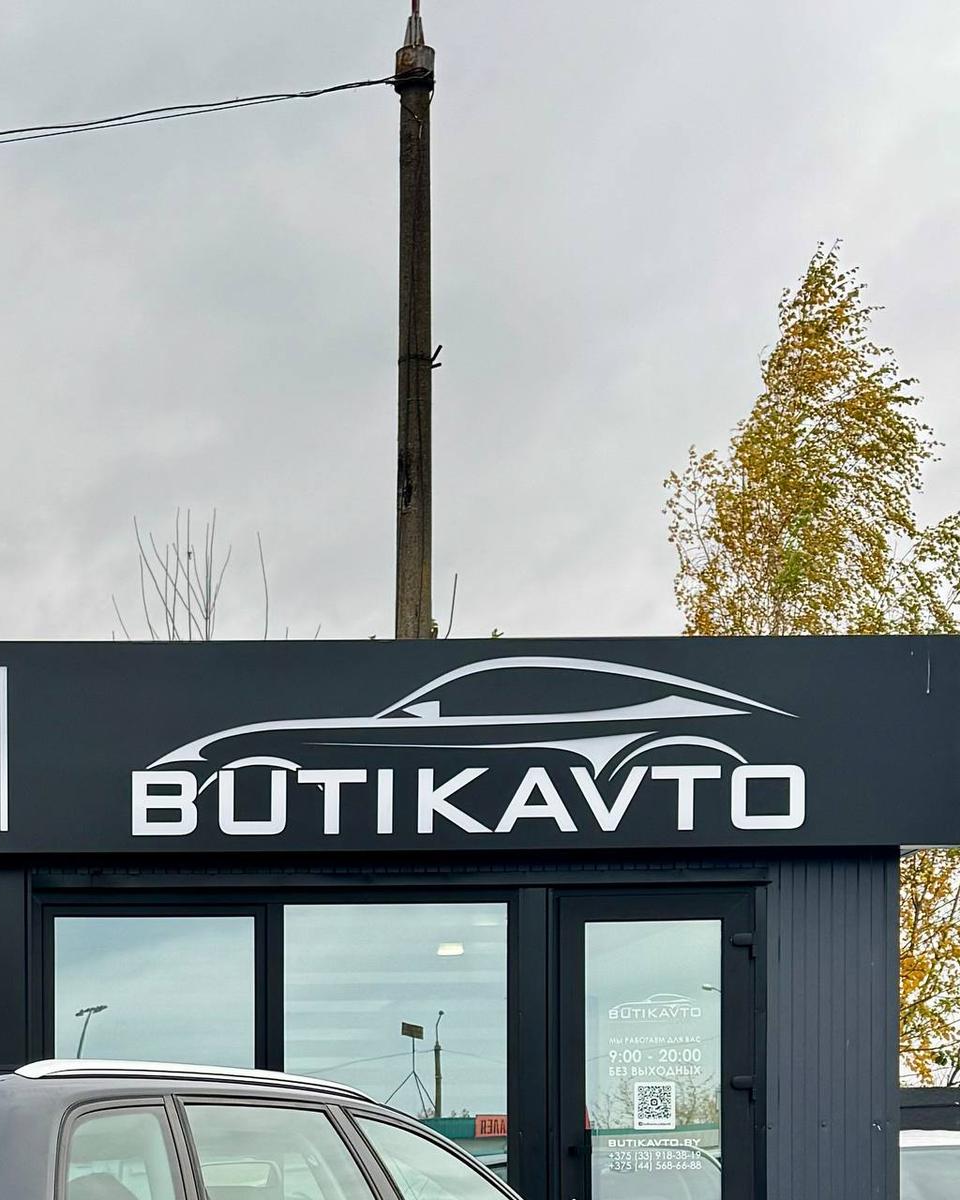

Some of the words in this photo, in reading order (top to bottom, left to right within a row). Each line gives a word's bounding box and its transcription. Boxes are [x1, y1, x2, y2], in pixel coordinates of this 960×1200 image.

[131, 764, 807, 836] BUTIKAVTO
[608, 1007, 701, 1019] BUTIKAVTO
[625, 1036, 665, 1044] РАБОТАЕМ
[609, 1049, 641, 1063] 9:00
[659, 1048, 701, 1062] 20:00
[609, 1066, 627, 1076] БЕЗ
[631, 1065, 701, 1076] ВЫХОДНЫХ
[608, 1138, 701, 1147] BUTIKAVTO.BY
[608, 1152, 632, 1160] +375
[635, 1151, 652, 1161] (33)
[655, 1151, 701, 1160] 918-38-19
[608, 1162, 632, 1170] +375
[635, 1161, 652, 1171] (44)
[655, 1161, 702, 1170] 568-66-88
